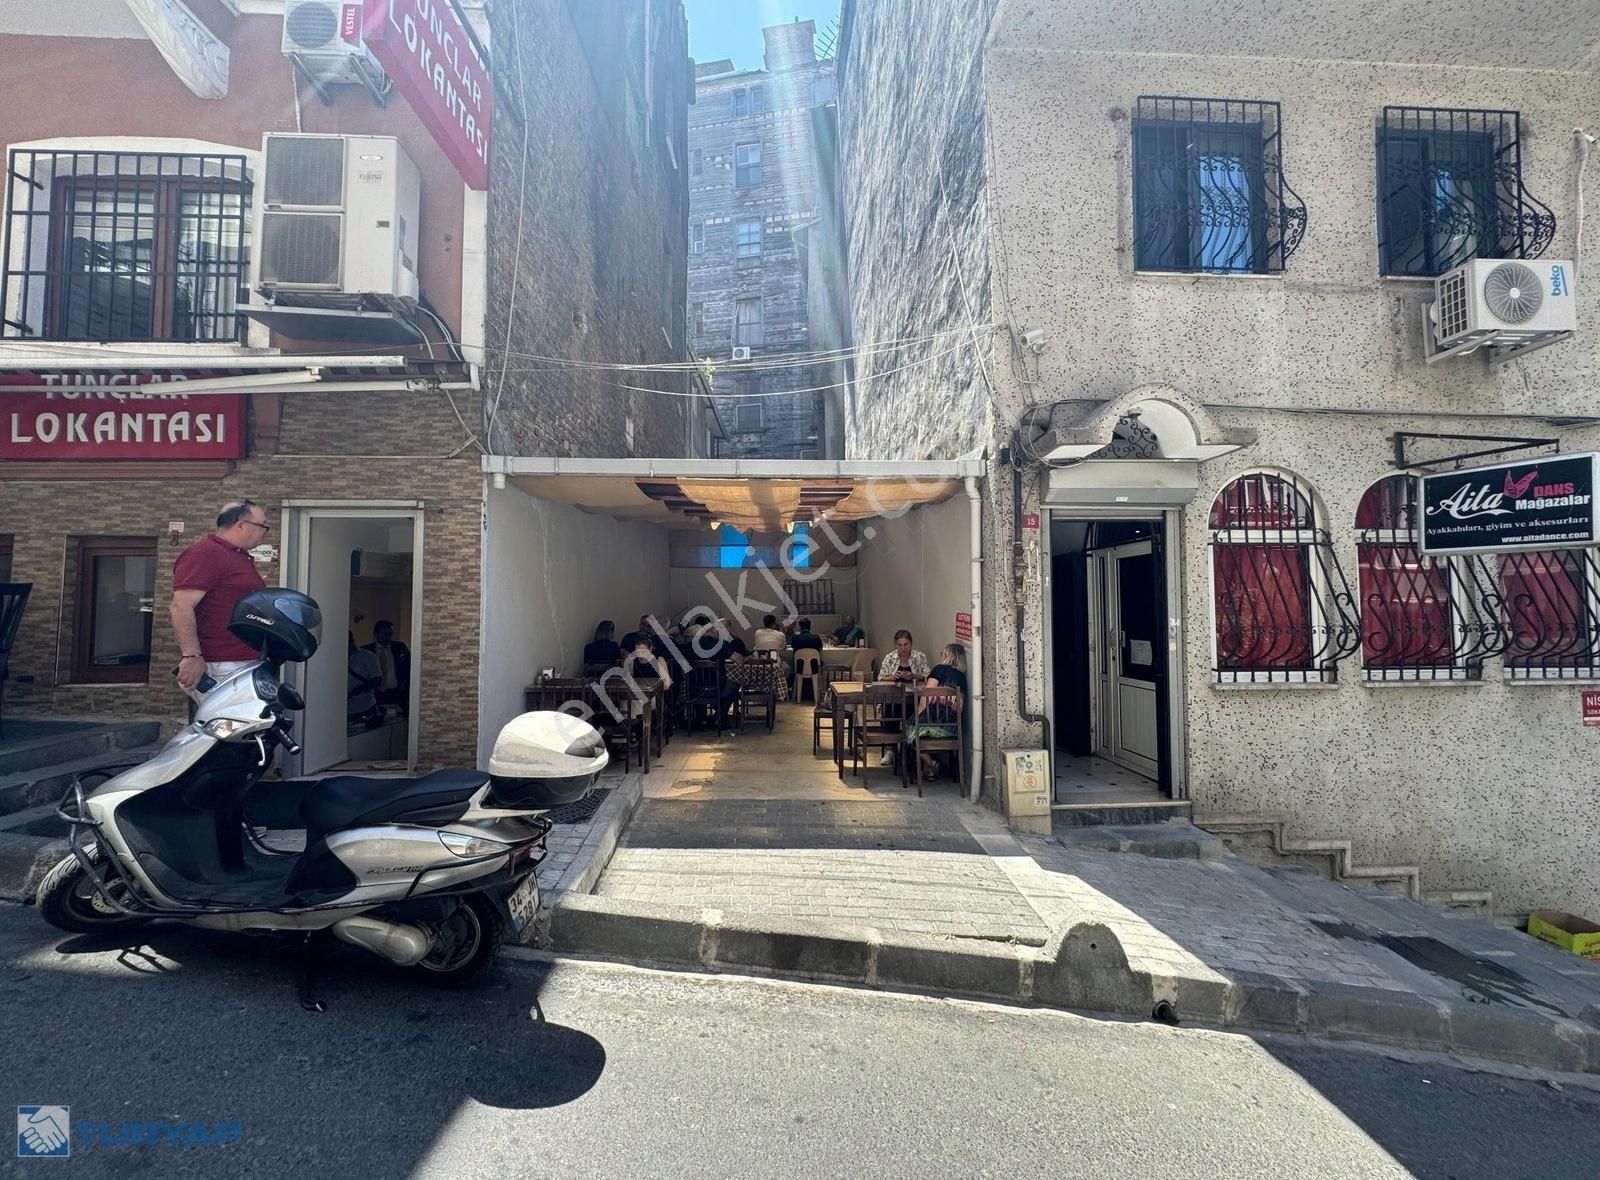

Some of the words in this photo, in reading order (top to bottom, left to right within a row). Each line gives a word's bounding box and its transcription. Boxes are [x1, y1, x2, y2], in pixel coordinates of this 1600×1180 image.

[345, 7, 356, 35] VESTEL
[417, 0, 482, 112] UNÇLAR
[389, 0, 488, 165] LOKANTASI
[1551, 265, 1561, 296] beko
[41, 374, 189, 403] TUNÇLAR
[11, 411, 225, 444] LOKANTASI
[1425, 482, 1515, 519] Aita
[1515, 494, 1591, 511] Mağazalar
[1533, 482, 1575, 497] DANS
[1026, 517, 1036, 526] 15
[1485, 522, 1512, 534] giyim
[1501, 531, 1589, 544] www.aitadance.com
